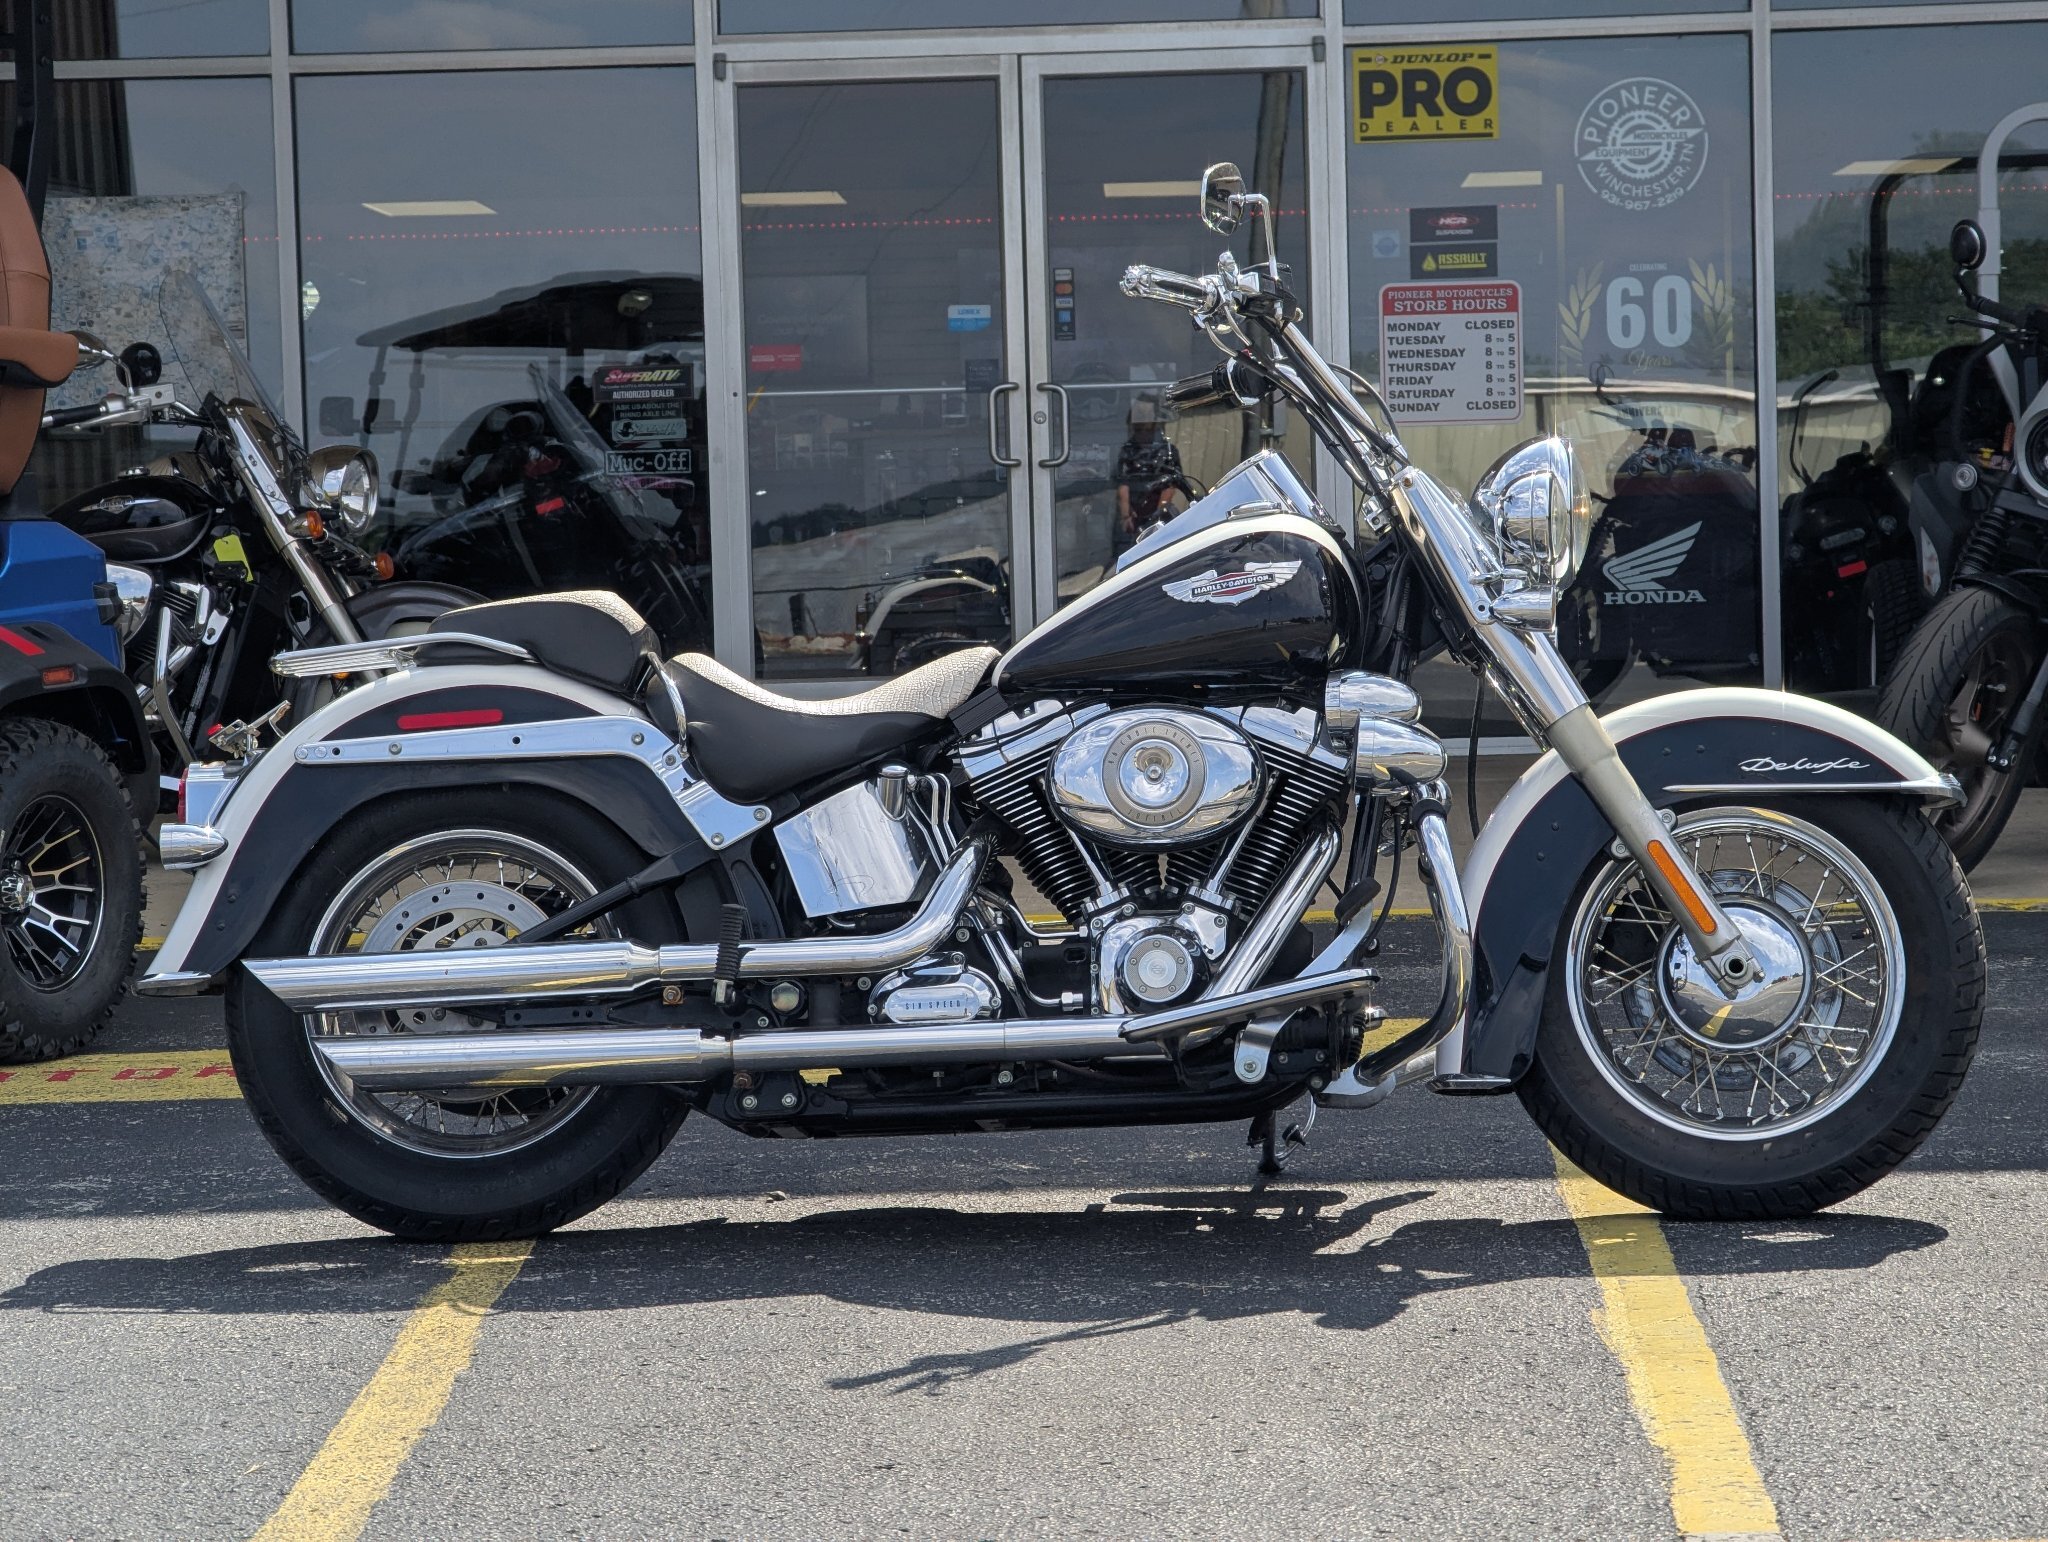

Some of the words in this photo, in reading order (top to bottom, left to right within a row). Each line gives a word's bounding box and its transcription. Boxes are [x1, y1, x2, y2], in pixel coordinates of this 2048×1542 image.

[1390, 53, 1475, 64] DUNLOP
[1359, 66, 1492, 119] PRO
[1584, 85, 1691, 143] PIONEER
[1360, 118, 1494, 133] DEALER
[1634, 131, 1689, 139] MOTORCYCLES
[1596, 147, 1650, 158] EQUIPMENT
[1680, 143, 1695, 162] TN
[1600, 187, 1685, 210] 931-967-2219
[1438, 253, 1487, 265] ASSAULT
[1388, 290, 1433, 300] PIONEER
[1436, 288, 1513, 299] MOTORCYCLES
[1394, 300, 1447, 313] STORE
[1452, 298, 1507, 311] HOURS
[1606, 275, 1692, 349] 60
[1387, 322, 1441, 332] MONDAY
[1465, 319, 1515, 330] CLOSED
[1387, 335, 1446, 346] TUESDAY
[1485, 333, 1492, 343] 8
[1508, 333, 1515, 342] 5
[1387, 348, 1466, 359] WEDNESDAY
[1485, 347, 1492, 356] 8
[1508, 347, 1516, 356] 5
[1388, 361, 1456, 373] THURSDAY
[1485, 360, 1493, 370] 8
[1508, 360, 1516, 369] 5
[1388, 375, 1434, 386] FRIDAY
[1486, 374, 1493, 383] 8
[1509, 373, 1516, 382] 5
[613, 390, 650, 399] AUTHORIZED
[651, 389, 674, 398] DEALER
[1388, 388, 1455, 400] SATURDAY
[1486, 387, 1493, 397] 8
[1509, 386, 1516, 396] 3
[642, 402, 666, 410] ABOUT
[1388, 402, 1440, 413] SUNDAY
[1466, 400, 1516, 410] CLOSED
[609, 452, 687, 472] Muc-Off
[1194, 574, 1271, 595] HARLEY-DAVIDSON
[1604, 590, 1707, 605] HONDA
[1738, 757, 1870, 774] Deluxe
[929, 1000, 961, 1009] SPEED
